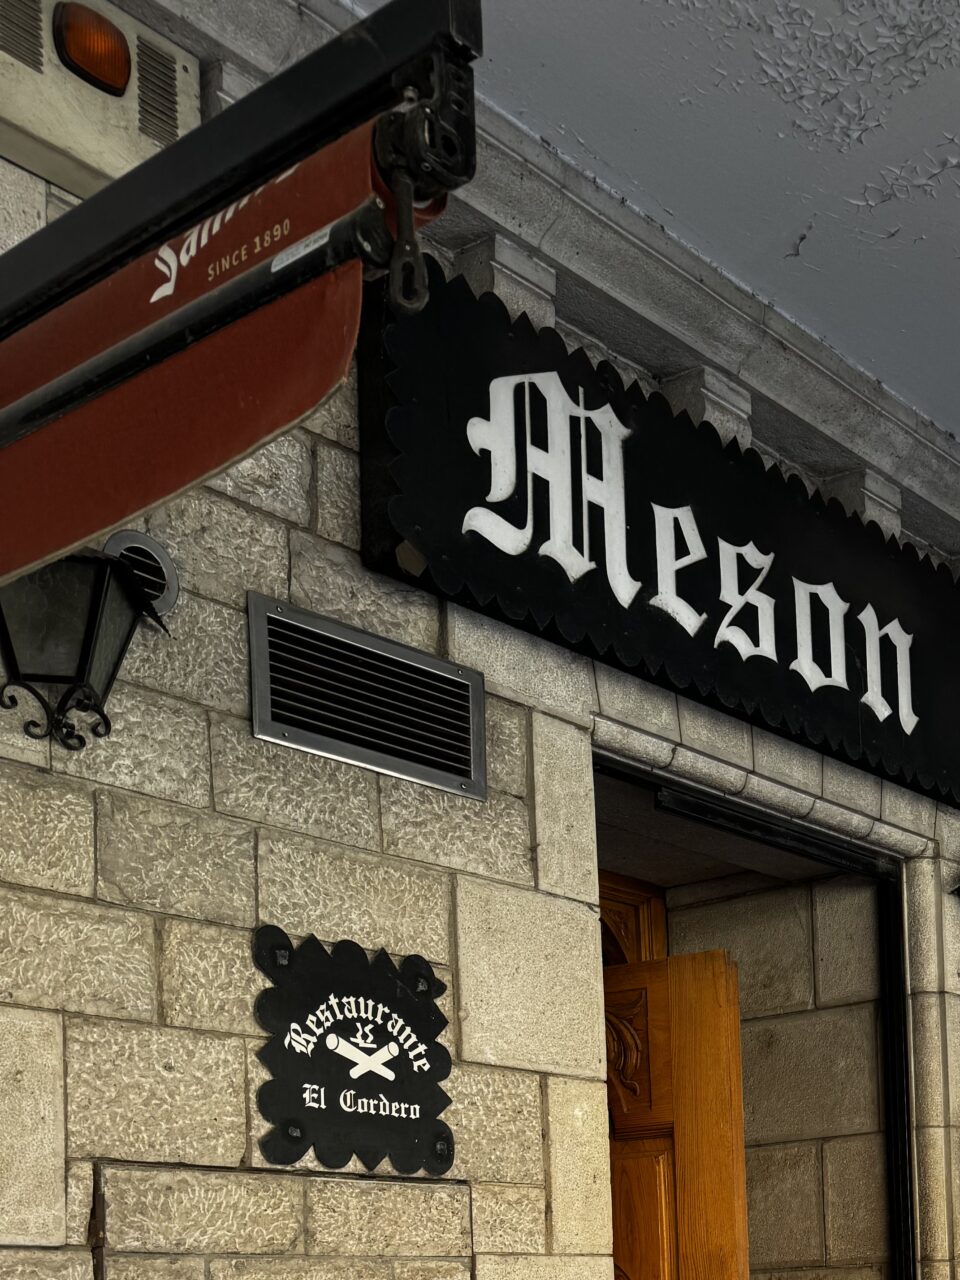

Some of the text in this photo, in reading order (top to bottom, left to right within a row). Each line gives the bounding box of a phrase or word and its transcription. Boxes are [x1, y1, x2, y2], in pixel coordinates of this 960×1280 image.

[207, 244, 249, 282] SINCE
[253, 218, 291, 255] 1890
[462, 371, 920, 736] Meson
[284, 992, 431, 1073] Restaurante
[302, 1083, 421, 1120] El Cordero
